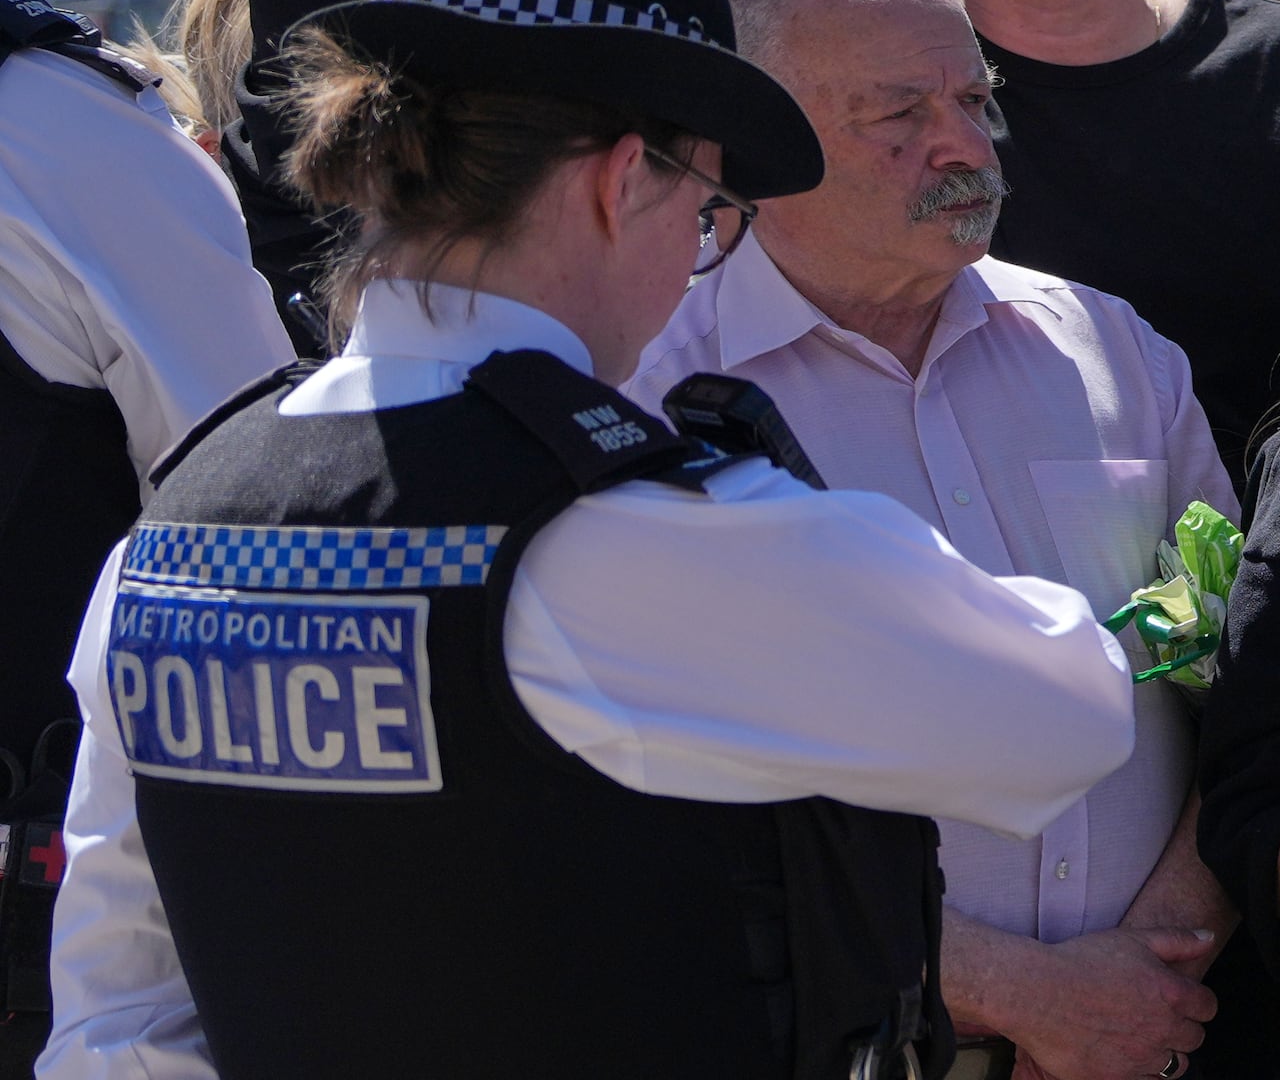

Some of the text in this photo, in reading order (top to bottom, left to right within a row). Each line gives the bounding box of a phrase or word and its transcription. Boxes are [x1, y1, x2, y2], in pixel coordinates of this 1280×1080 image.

[590, 421, 648, 453] 1855
[115, 602, 403, 654] METROPOLITAN
[112, 650, 415, 772] POLICE
